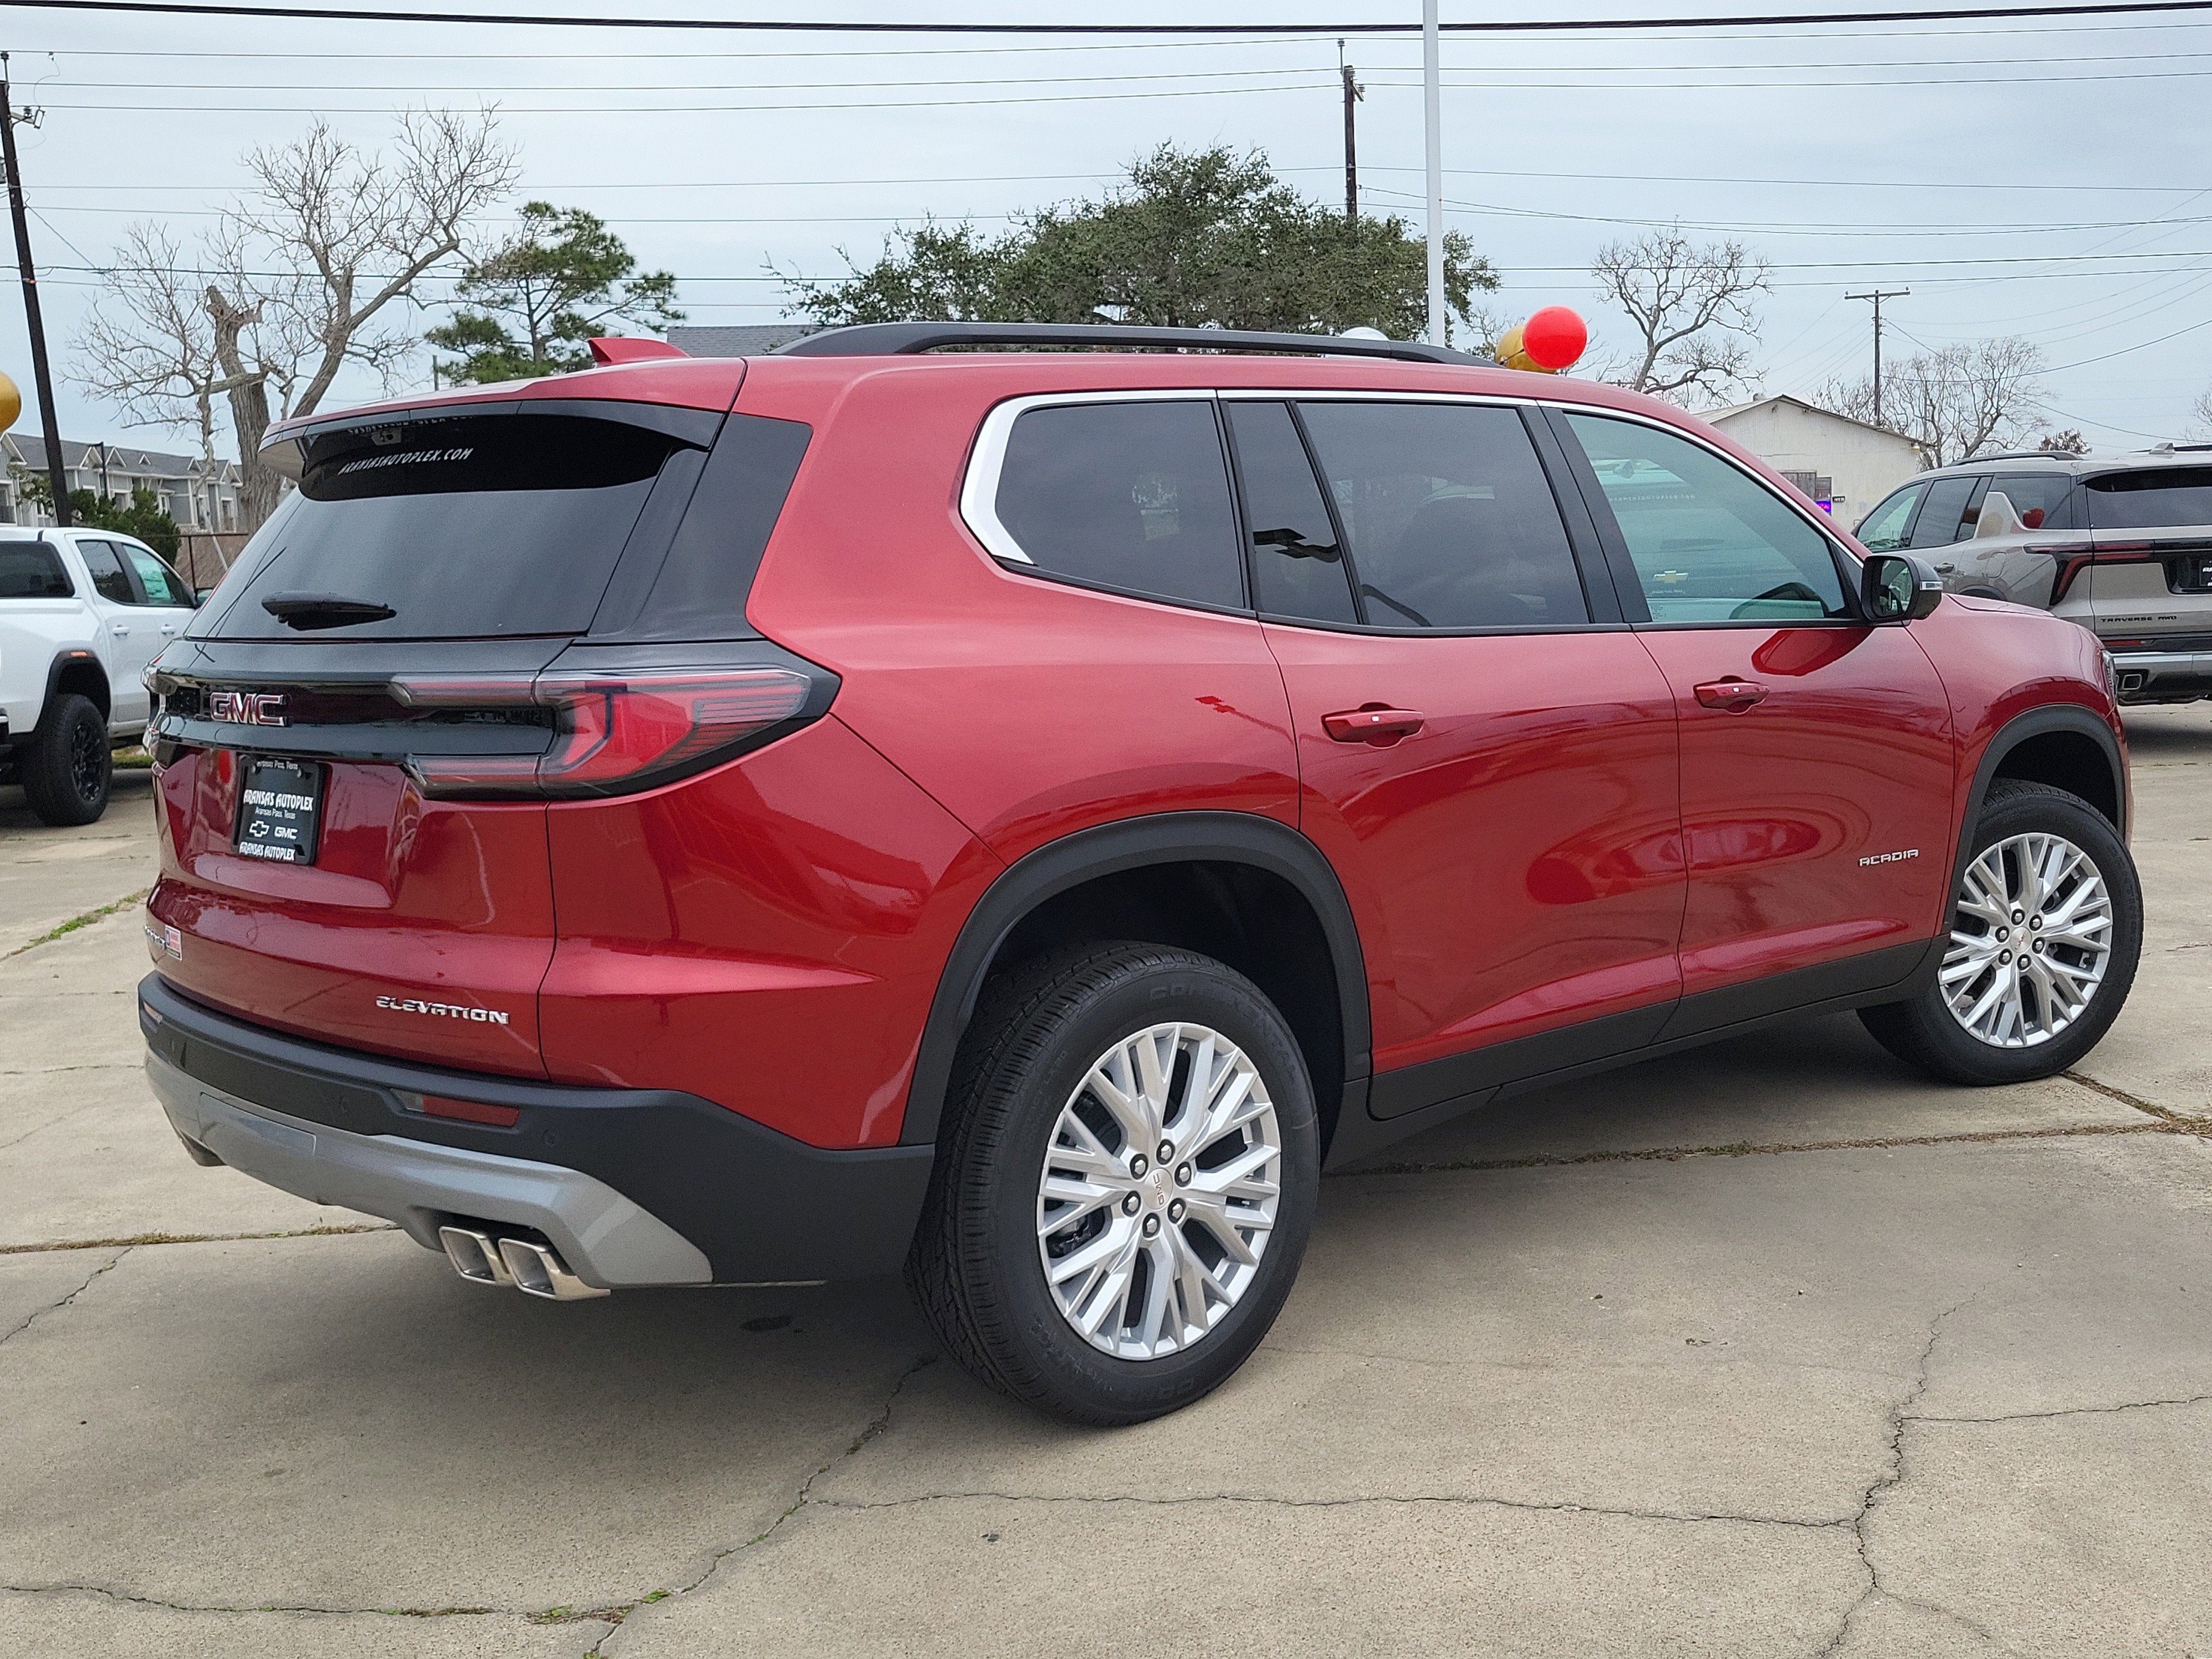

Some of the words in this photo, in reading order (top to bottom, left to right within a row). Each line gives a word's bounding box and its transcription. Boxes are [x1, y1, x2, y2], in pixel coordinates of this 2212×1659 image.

[337, 448, 474, 476] ARANSASAUTOPLEX.COM
[210, 692, 285, 727] GMC
[243, 789, 275, 807] ARANSAS
[275, 793, 314, 811] AUTOPLEX
[274, 826, 298, 840] GMC
[239, 841, 264, 857] ARANSAS
[264, 845, 296, 861] AUTOPLEX
[1859, 849, 1919, 867] ACADIA
[376, 995, 509, 1024] ELEVATION
[1153, 1173, 1165, 1205] GMC
